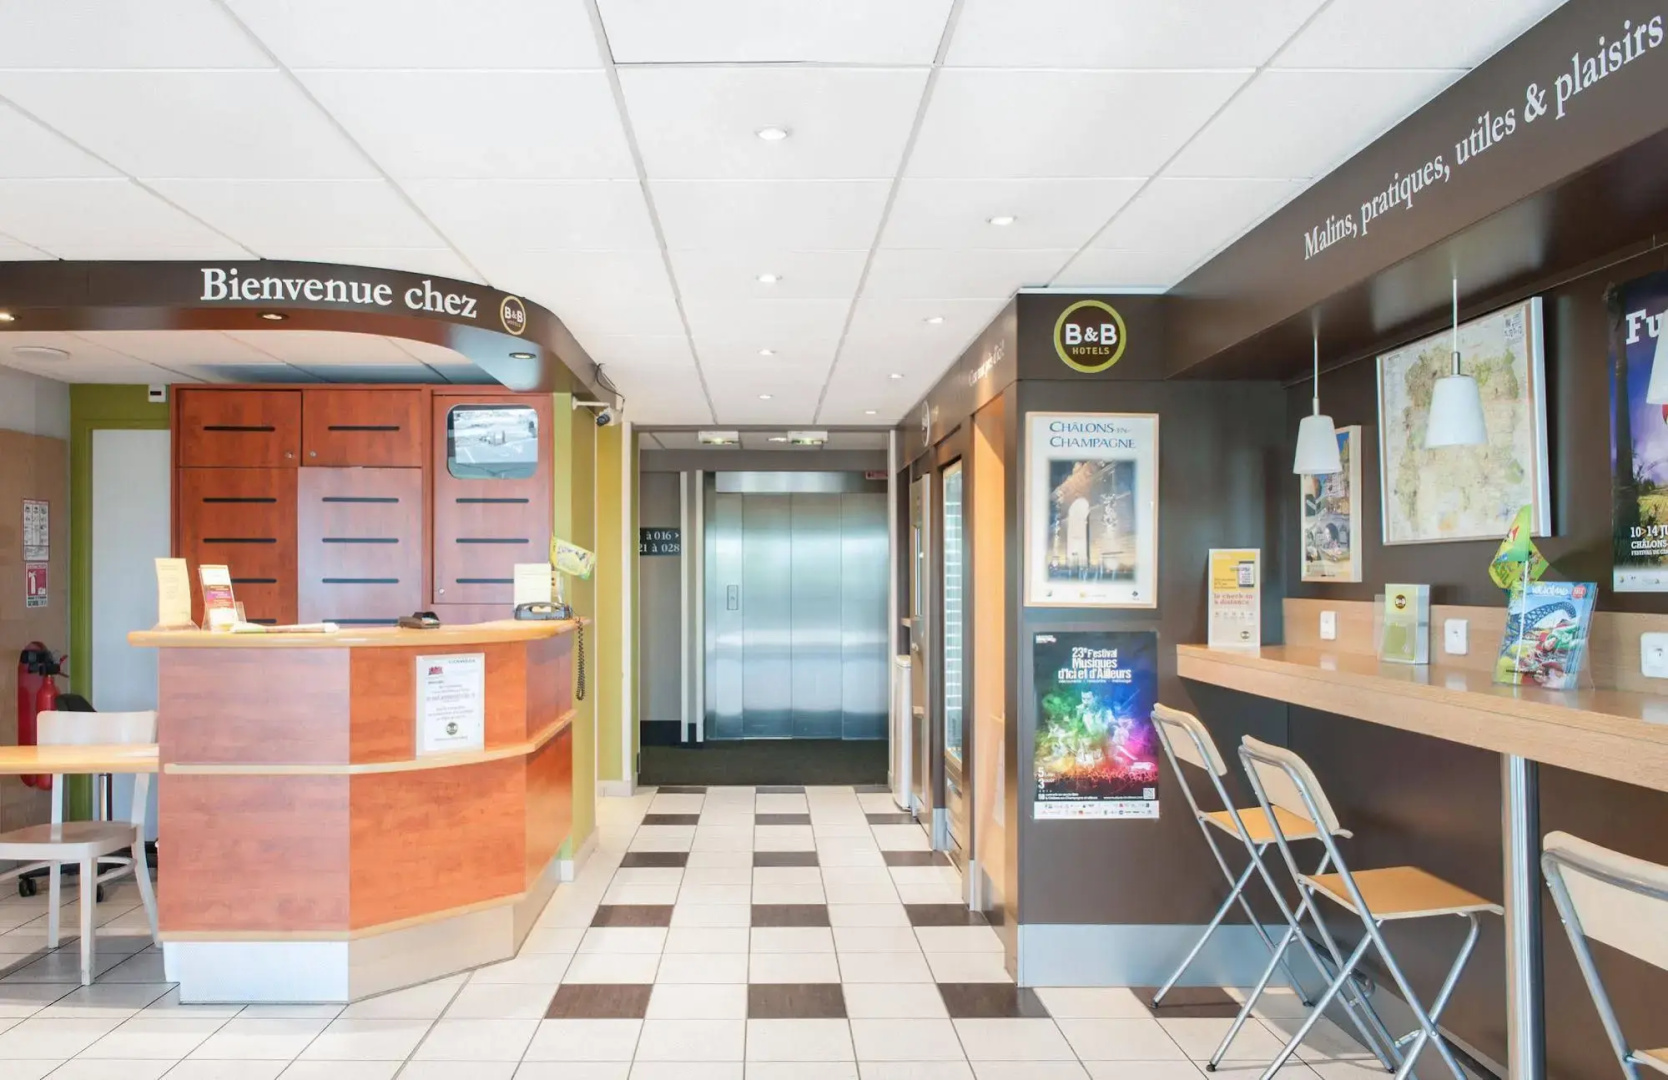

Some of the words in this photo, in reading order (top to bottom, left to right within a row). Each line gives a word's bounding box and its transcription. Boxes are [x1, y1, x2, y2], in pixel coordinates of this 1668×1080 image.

[1304, 214, 1357, 260] Malins,
[1361, 155, 1450, 236] pratiques,
[1455, 108, 1516, 165] utiles
[1524, 82, 1547, 123] &
[1554, 15, 1664, 120] plaisirs
[200, 268, 392, 306] Bienvenue
[404, 280, 477, 318] chez
[504, 306, 523, 323] B&B
[1065, 323, 1117, 345] B&B
[1072, 347, 1110, 355] HOTELS
[1049, 436, 1136, 449] CHAMPAGNE
[646, 531, 652, 541] à
[653, 531, 672, 541] 016
[651, 543, 658, 553] à
[661, 543, 680, 553] 028
[1087, 648, 1118, 658] Festival
[1072, 658, 1117, 669] Musiques
